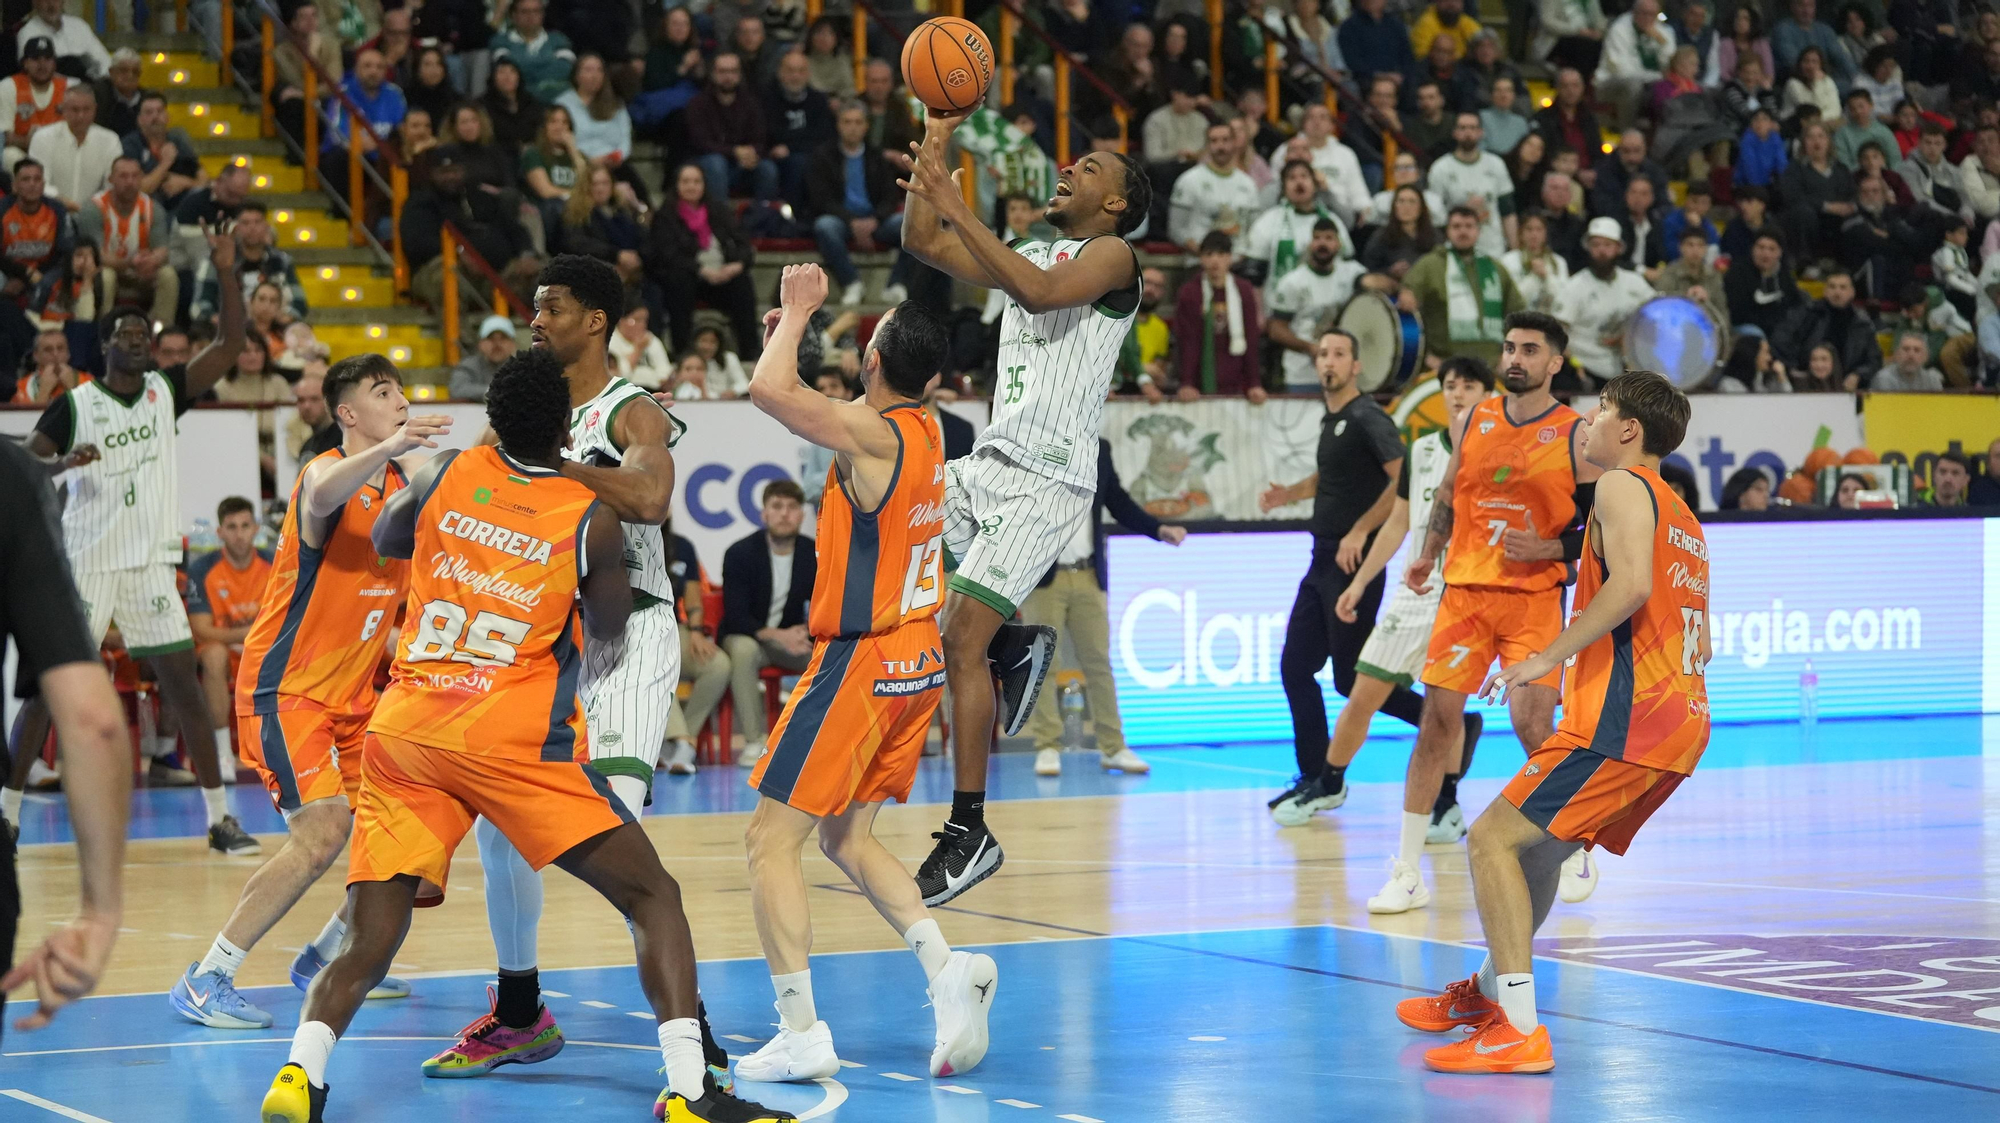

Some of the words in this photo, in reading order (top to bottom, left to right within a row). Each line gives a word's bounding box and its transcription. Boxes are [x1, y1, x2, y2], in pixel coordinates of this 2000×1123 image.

[1005, 365, 1027, 404] 35
[438, 509, 553, 566] CORREIA
[1487, 519, 1508, 546] 7
[431, 550, 546, 613] Wheyland
[900, 533, 942, 617] 13
[361, 609, 384, 642] 8
[406, 598, 534, 667] 85
[1448, 644, 1471, 669] 7
